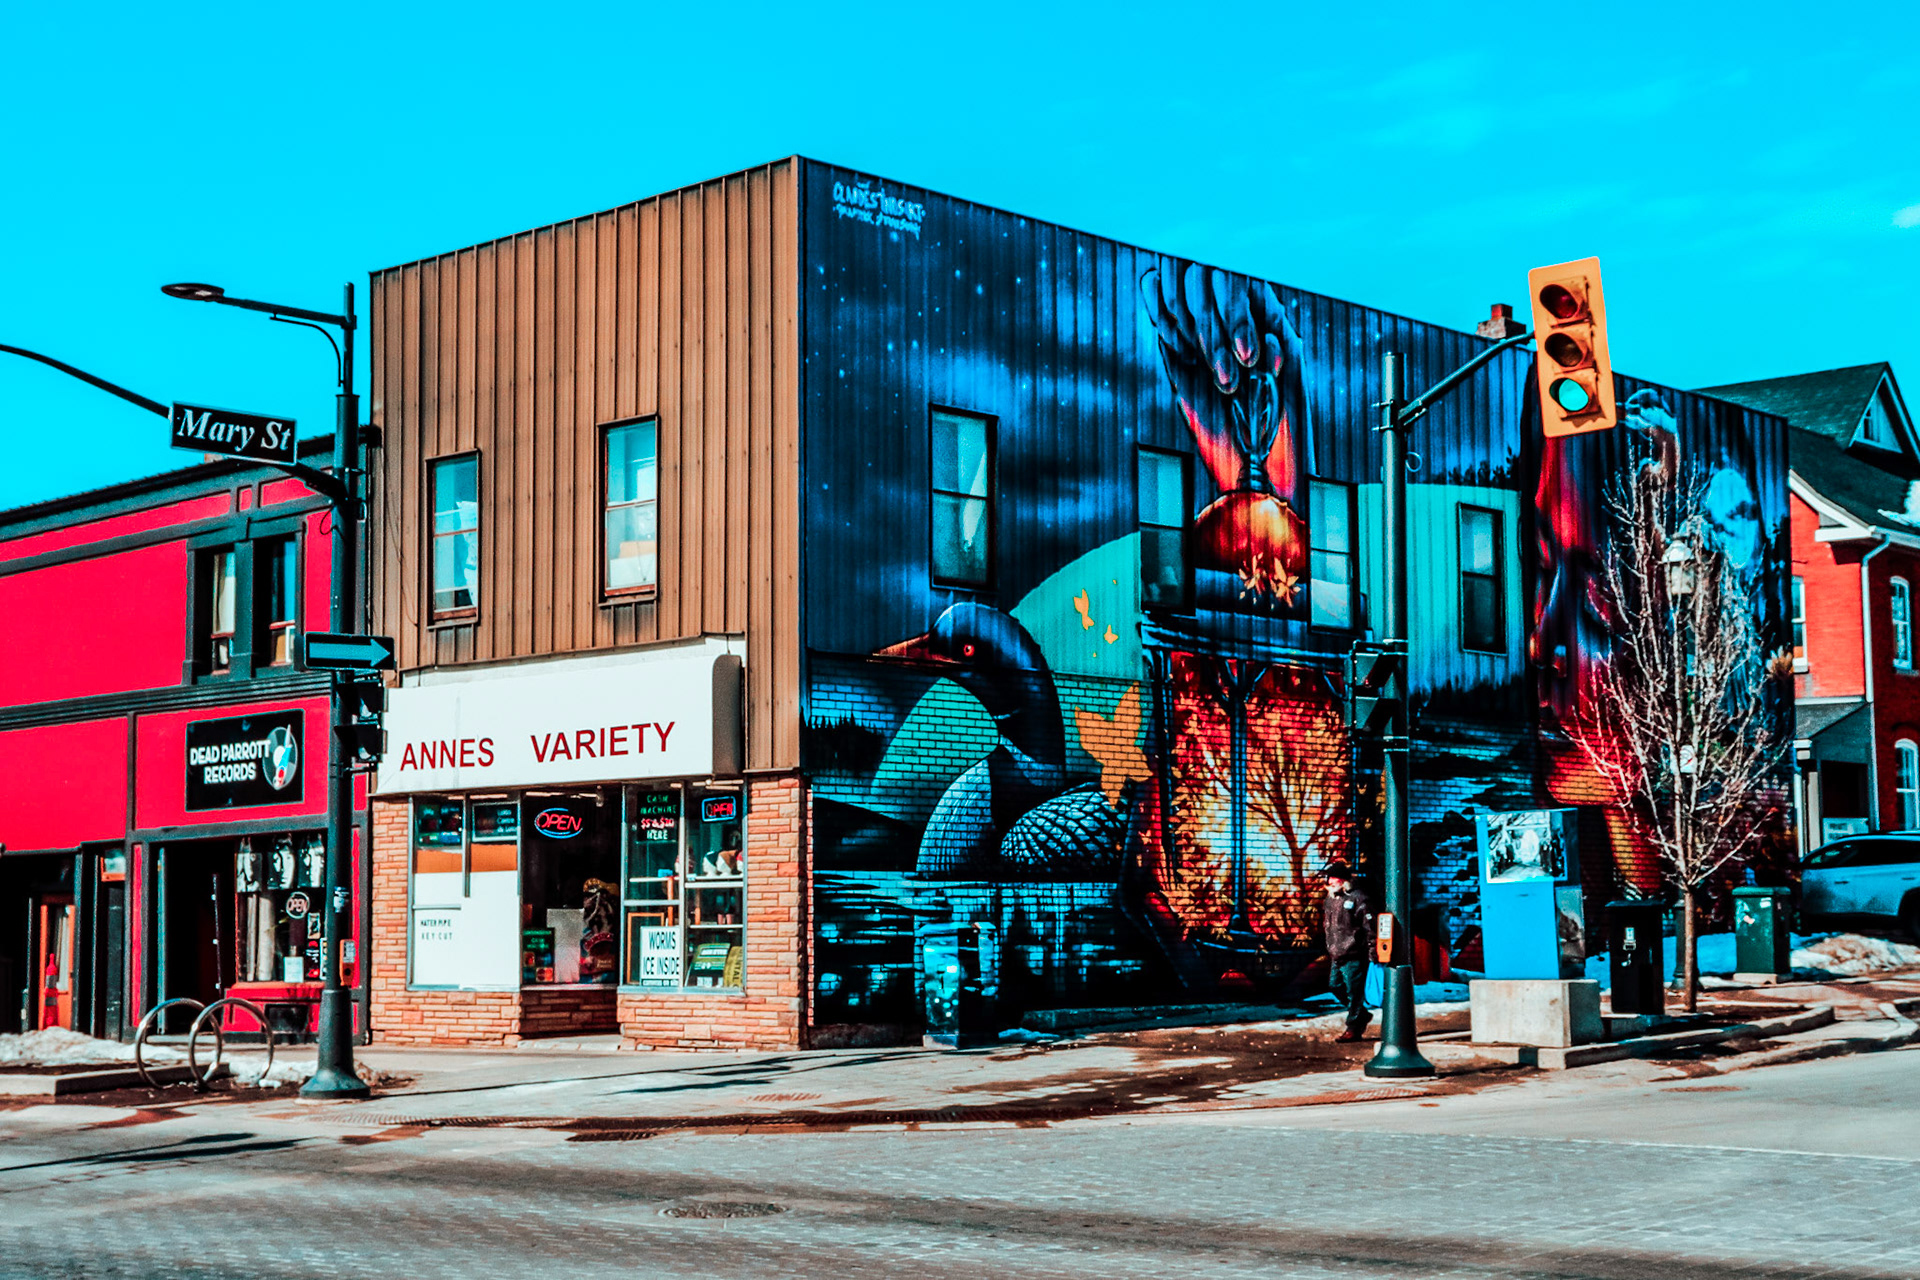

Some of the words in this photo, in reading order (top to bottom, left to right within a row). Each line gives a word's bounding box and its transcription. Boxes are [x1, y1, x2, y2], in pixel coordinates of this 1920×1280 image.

[176, 409, 255, 453] Mary
[260, 420, 292, 451] St
[189, 745, 220, 766] DEAD
[221, 738, 271, 763] PARROTT
[400, 737, 494, 771] ANNES
[530, 721, 676, 763] VARIETY
[203, 762, 257, 785] RECORDS
[646, 794, 669, 804] CASH
[640, 804, 677, 815] MACHINE
[706, 802, 734, 818] OPEN
[536, 812, 583, 832] OPEN
[646, 829, 668, 840] HERE
[288, 898, 308, 913] OPEN
[438, 932, 452, 940] CUT
[648, 931, 676, 950] WORMS
[643, 956, 655, 975] ICE
[657, 956, 680, 975] INSIDE
